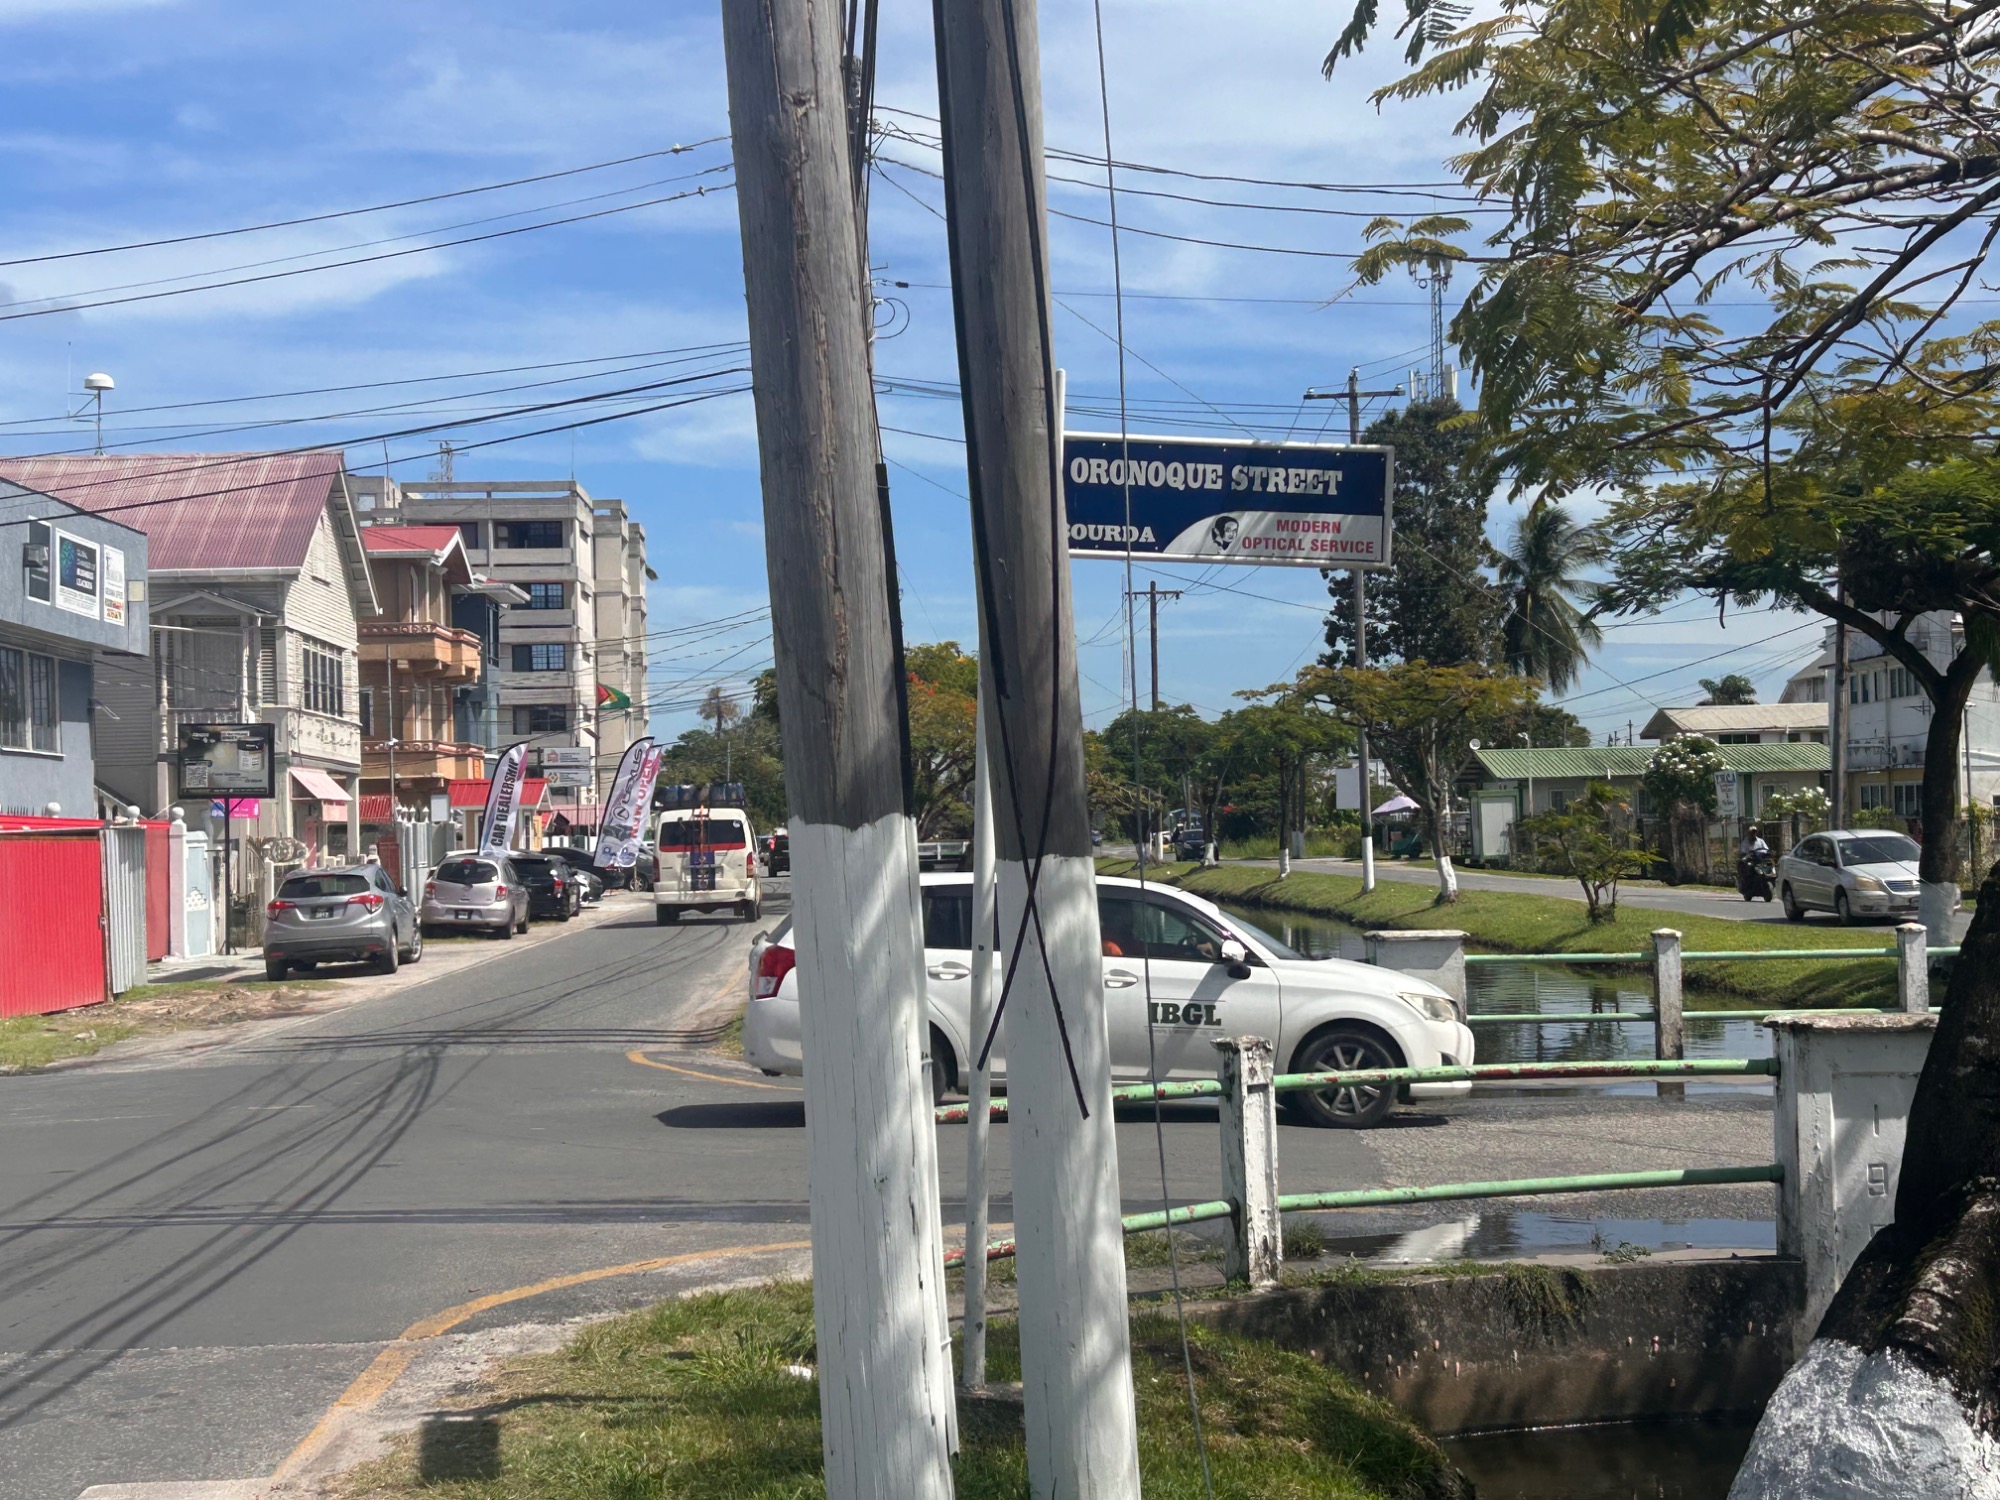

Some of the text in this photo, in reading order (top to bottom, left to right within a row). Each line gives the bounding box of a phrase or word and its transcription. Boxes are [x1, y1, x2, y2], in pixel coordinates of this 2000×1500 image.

[1070, 457, 1343, 495] ORONOQUE STREET
[1242, 536, 1374, 554] OPTICAL SERVICE
[1276, 520, 1342, 534] MODERN
[621, 748, 643, 805] LEXUS
[490, 757, 519, 847] CAR DEALERSHIP
